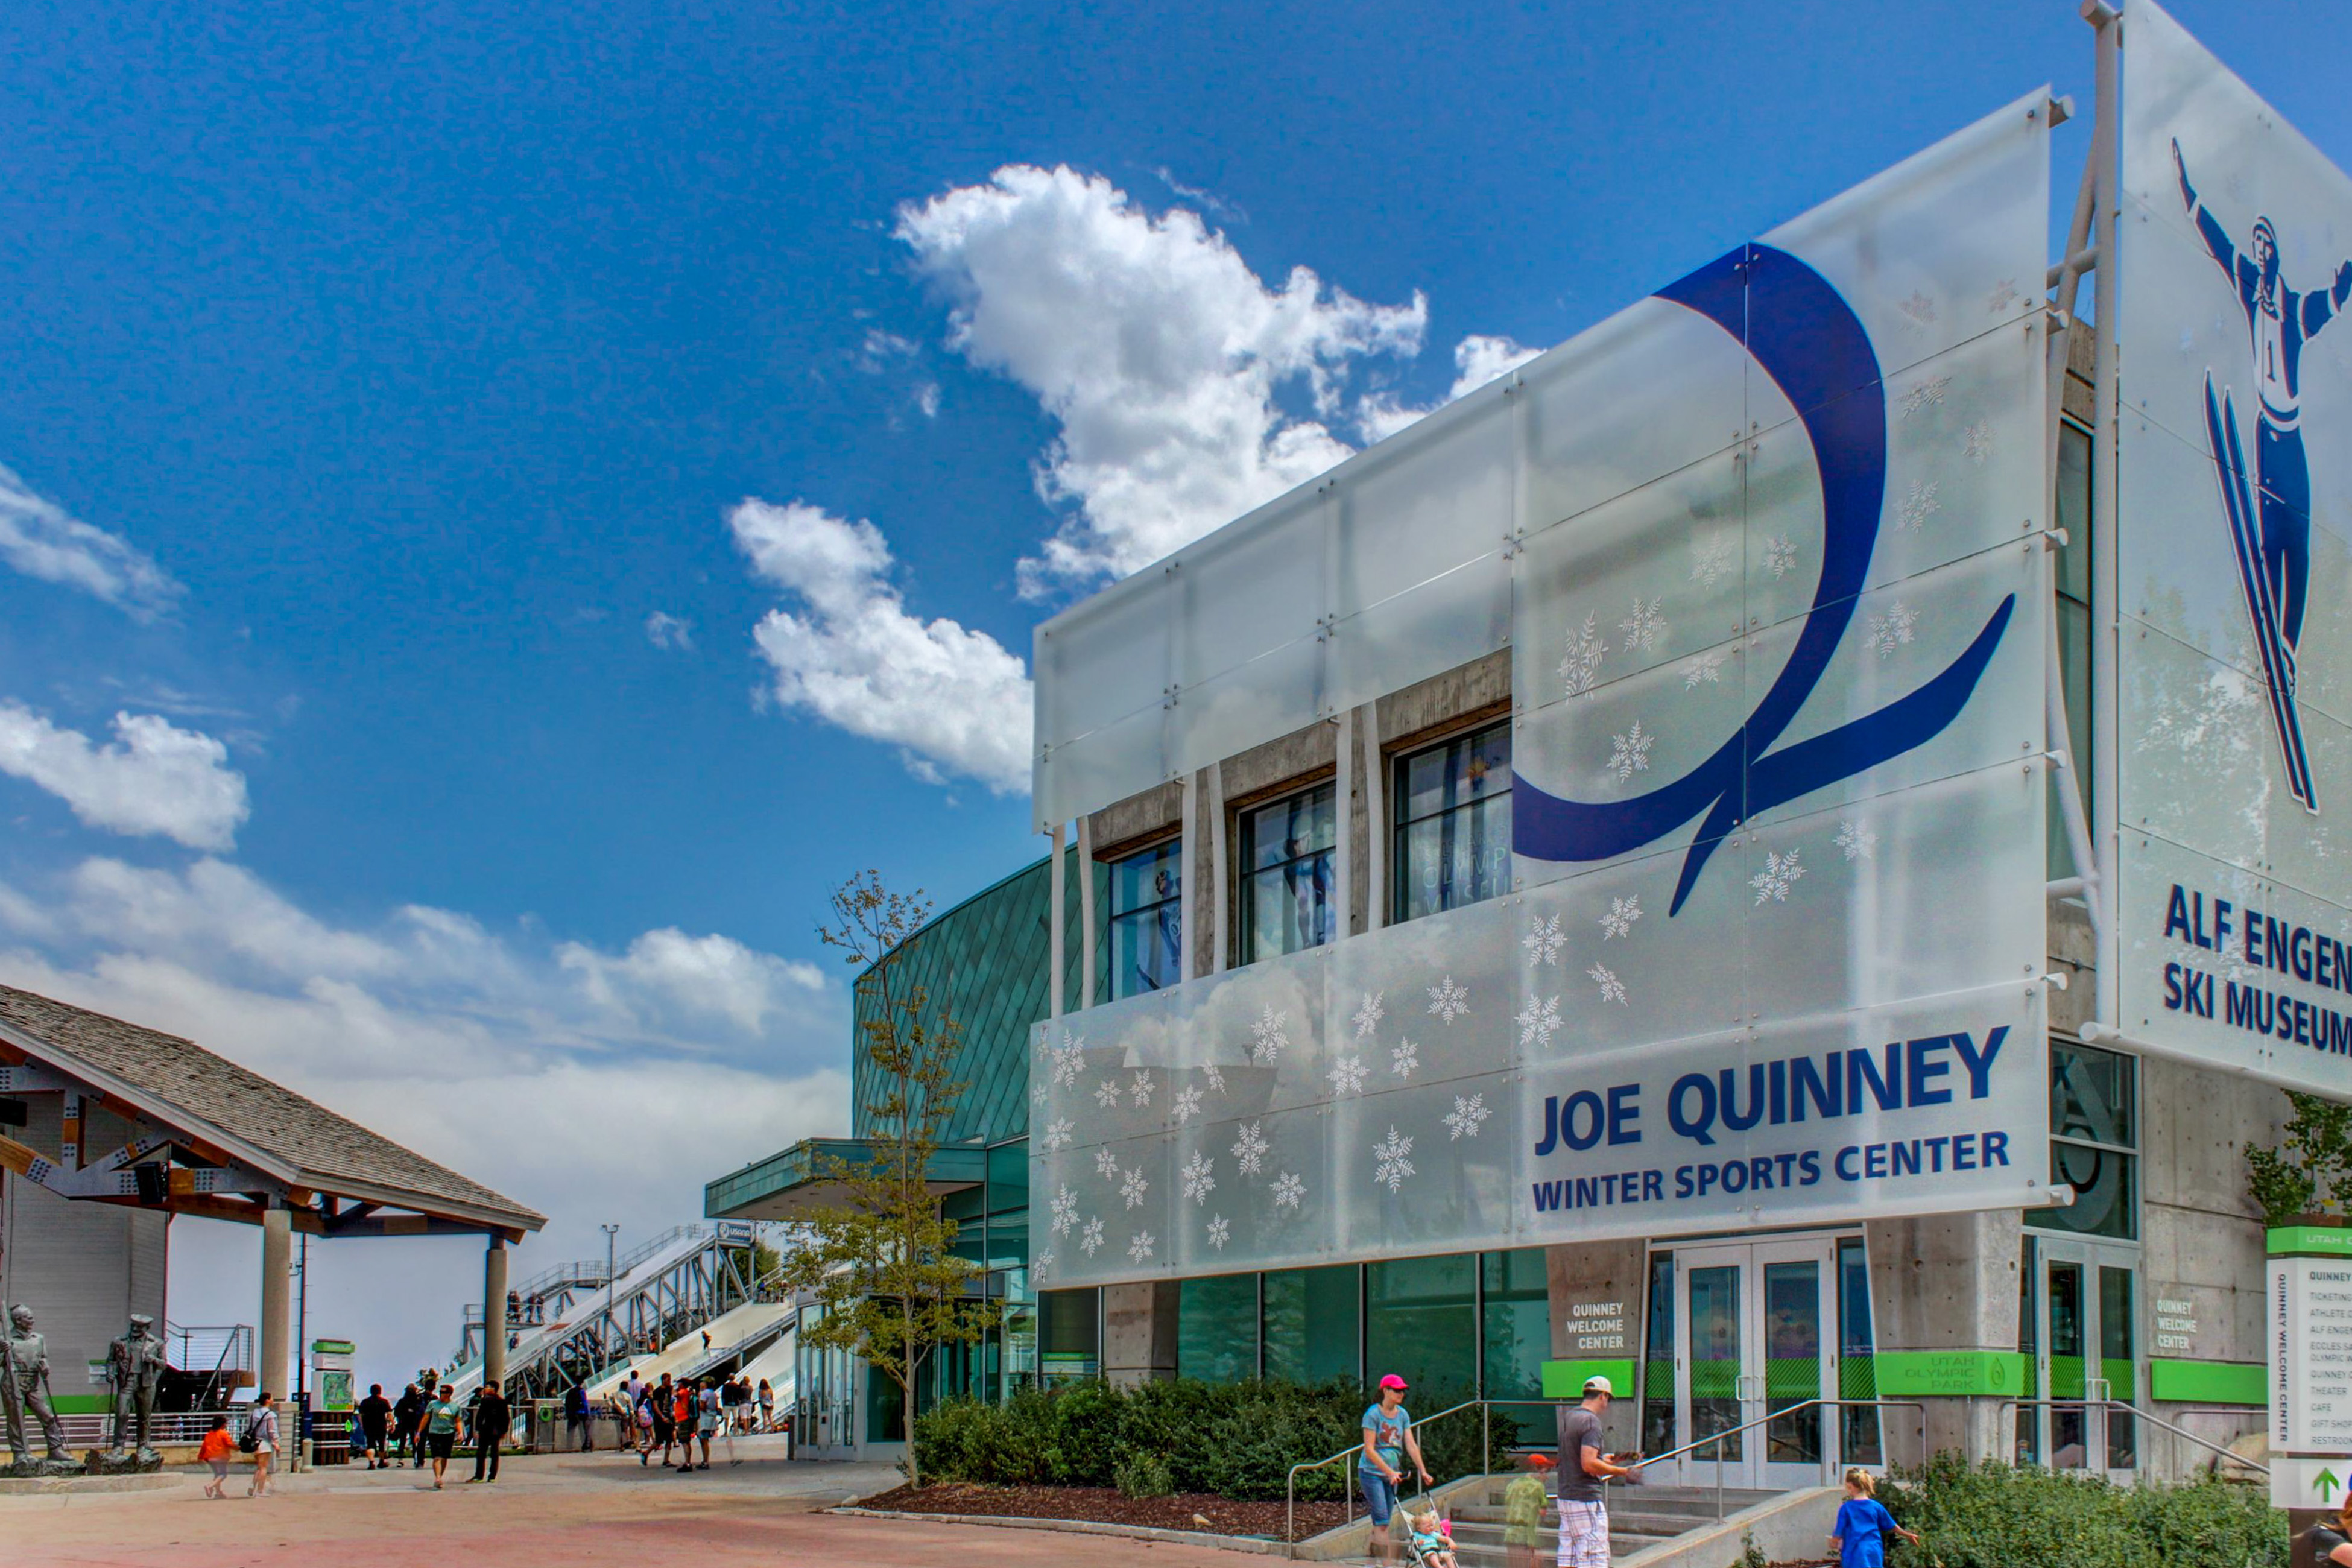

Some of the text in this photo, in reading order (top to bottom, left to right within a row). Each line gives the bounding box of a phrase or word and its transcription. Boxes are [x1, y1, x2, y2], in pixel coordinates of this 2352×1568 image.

[2163, 884, 2352, 996] ALF ENGEN
[2164, 962, 2352, 1058] SKI MUSEUM
[1535, 1025, 2011, 1156] JOE QUINNEY
[1532, 1131, 2011, 1212] WINTER SPORTS CENTER
[2307, 1235, 2342, 1244] UTAH
[2310, 1271, 2351, 1282] QUINNEY
[1573, 1303, 1623, 1317] QUINNEY
[2157, 1300, 2192, 1315] QUINNEY
[2310, 1309, 2345, 1318] ATHLETE
[1567, 1319, 1623, 1333] WELCOME
[2158, 1317, 2197, 1333] WELCOME
[1579, 1336, 1624, 1349] CENTER
[2158, 1335, 2189, 1350] CENTER
[2311, 1341, 2342, 1350] ECCLES
[1931, 1356, 1975, 1366] UTAH
[2278, 1330, 2287, 1391] WELCOME
[2311, 1353, 2344, 1362] OLYMPIC
[1905, 1368, 1975, 1378] OLYMPIC
[2311, 1370, 2346, 1379] QUINNEY
[1931, 1380, 1975, 1389] PARK
[2311, 1403, 2331, 1412] CAFE
[2279, 1394, 2287, 1441] CENTER
